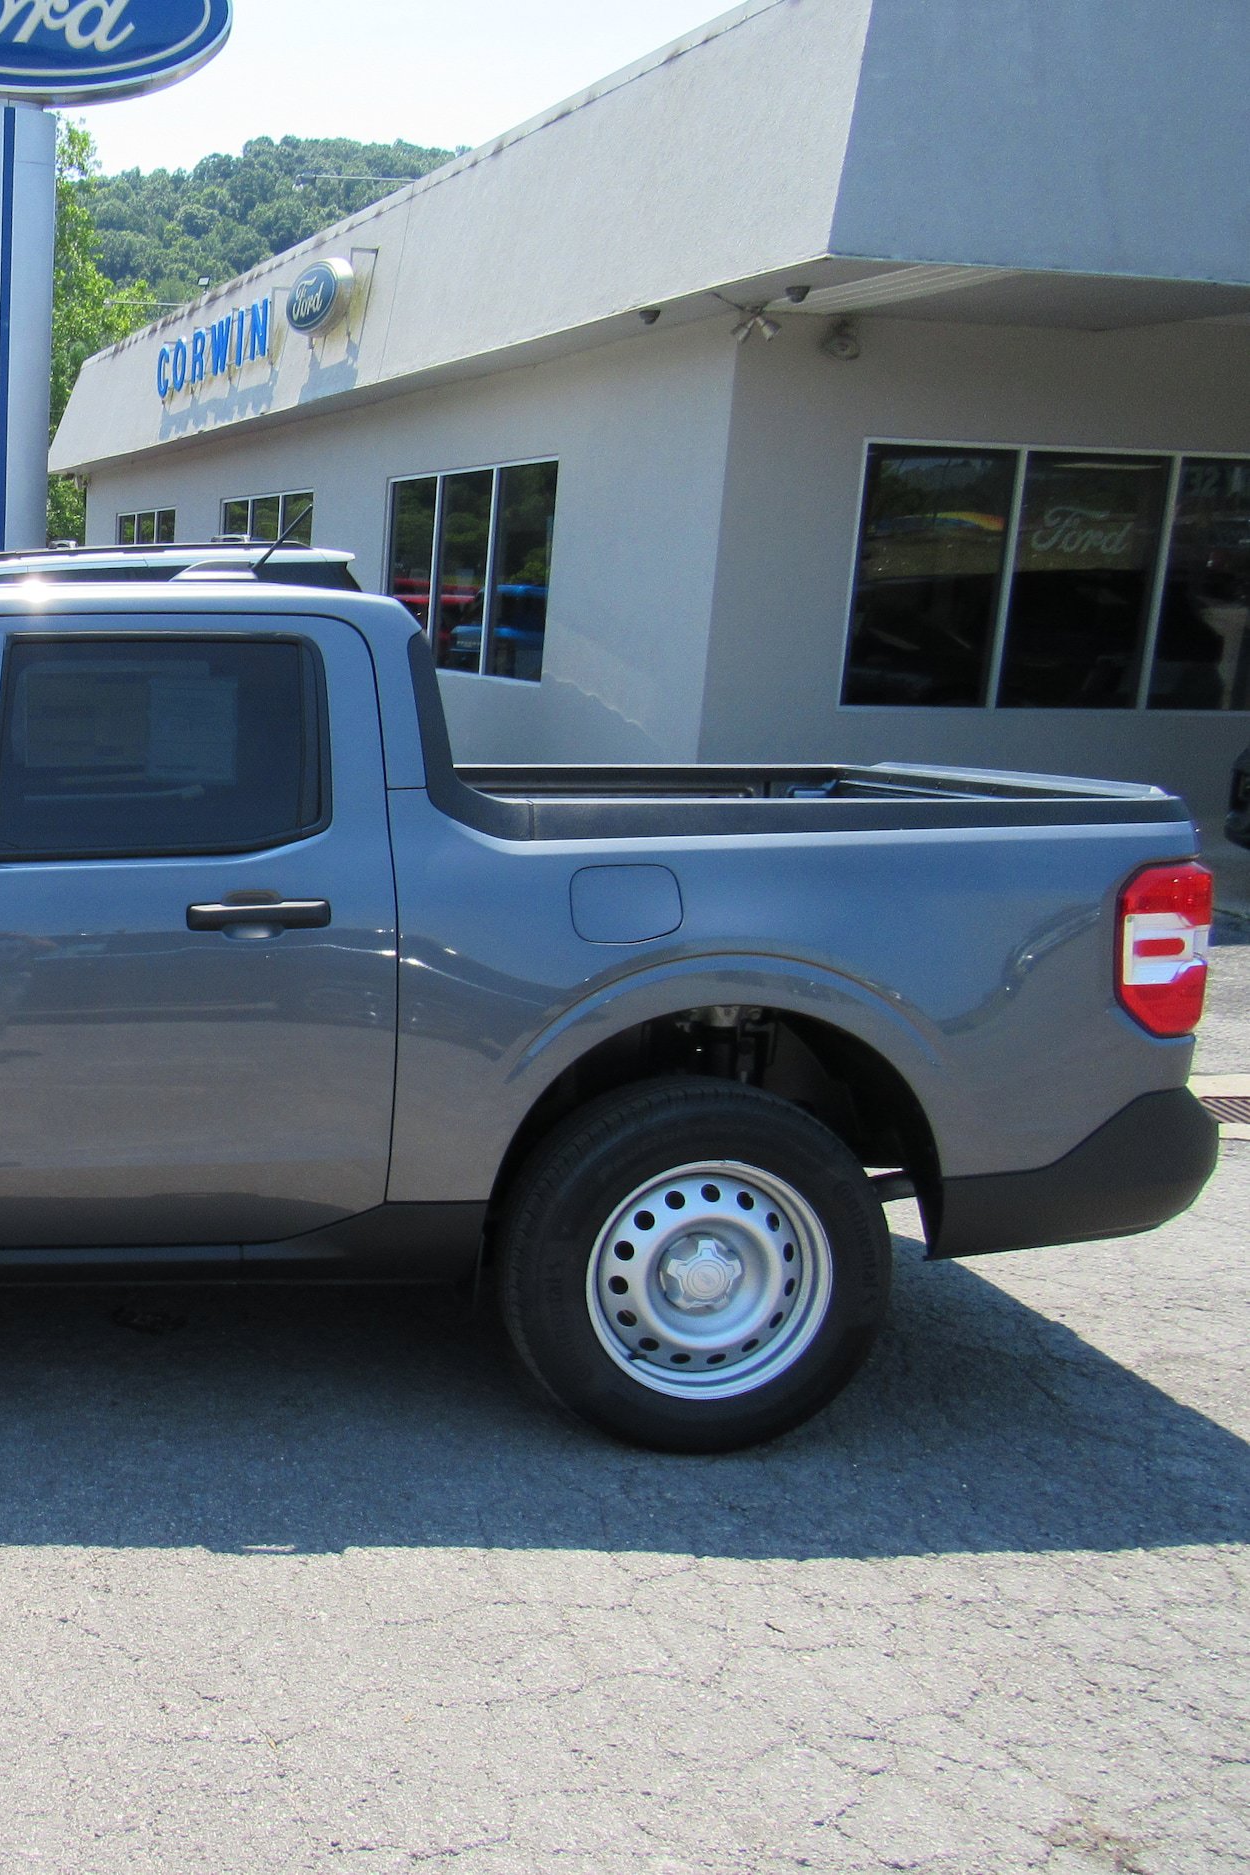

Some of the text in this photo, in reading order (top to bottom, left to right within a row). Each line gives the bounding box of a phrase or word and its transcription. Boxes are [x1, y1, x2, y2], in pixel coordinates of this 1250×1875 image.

[292, 276, 325, 319] Ford
[157, 295, 271, 399] CORWIN
[1031, 506, 1134, 555] Ford
